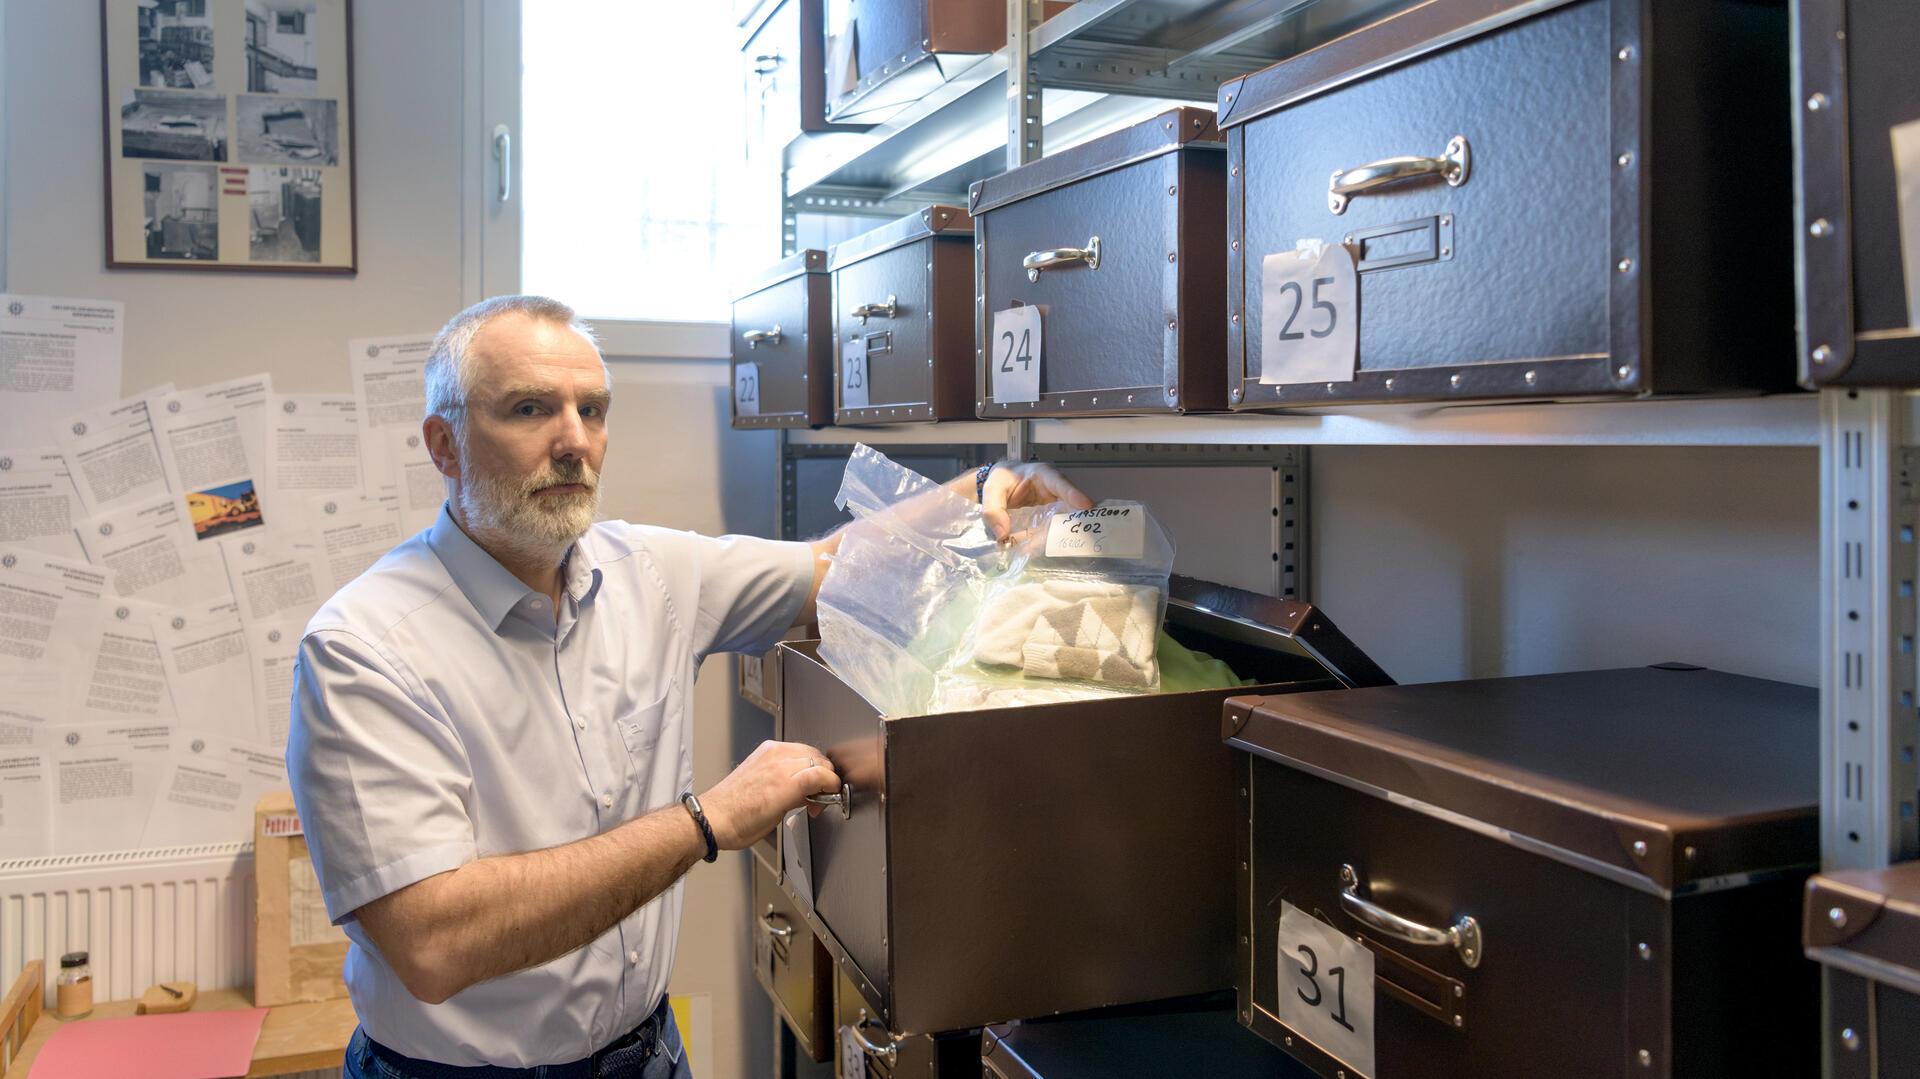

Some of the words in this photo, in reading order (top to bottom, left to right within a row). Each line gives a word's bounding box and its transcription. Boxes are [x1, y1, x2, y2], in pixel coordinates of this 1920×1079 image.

[1279, 276, 1337, 341] 25
[847, 357, 862, 389] 23
[1001, 328, 1032, 373] 24
[740, 376, 755, 402] 22
[1297, 944, 1355, 1033] 31
